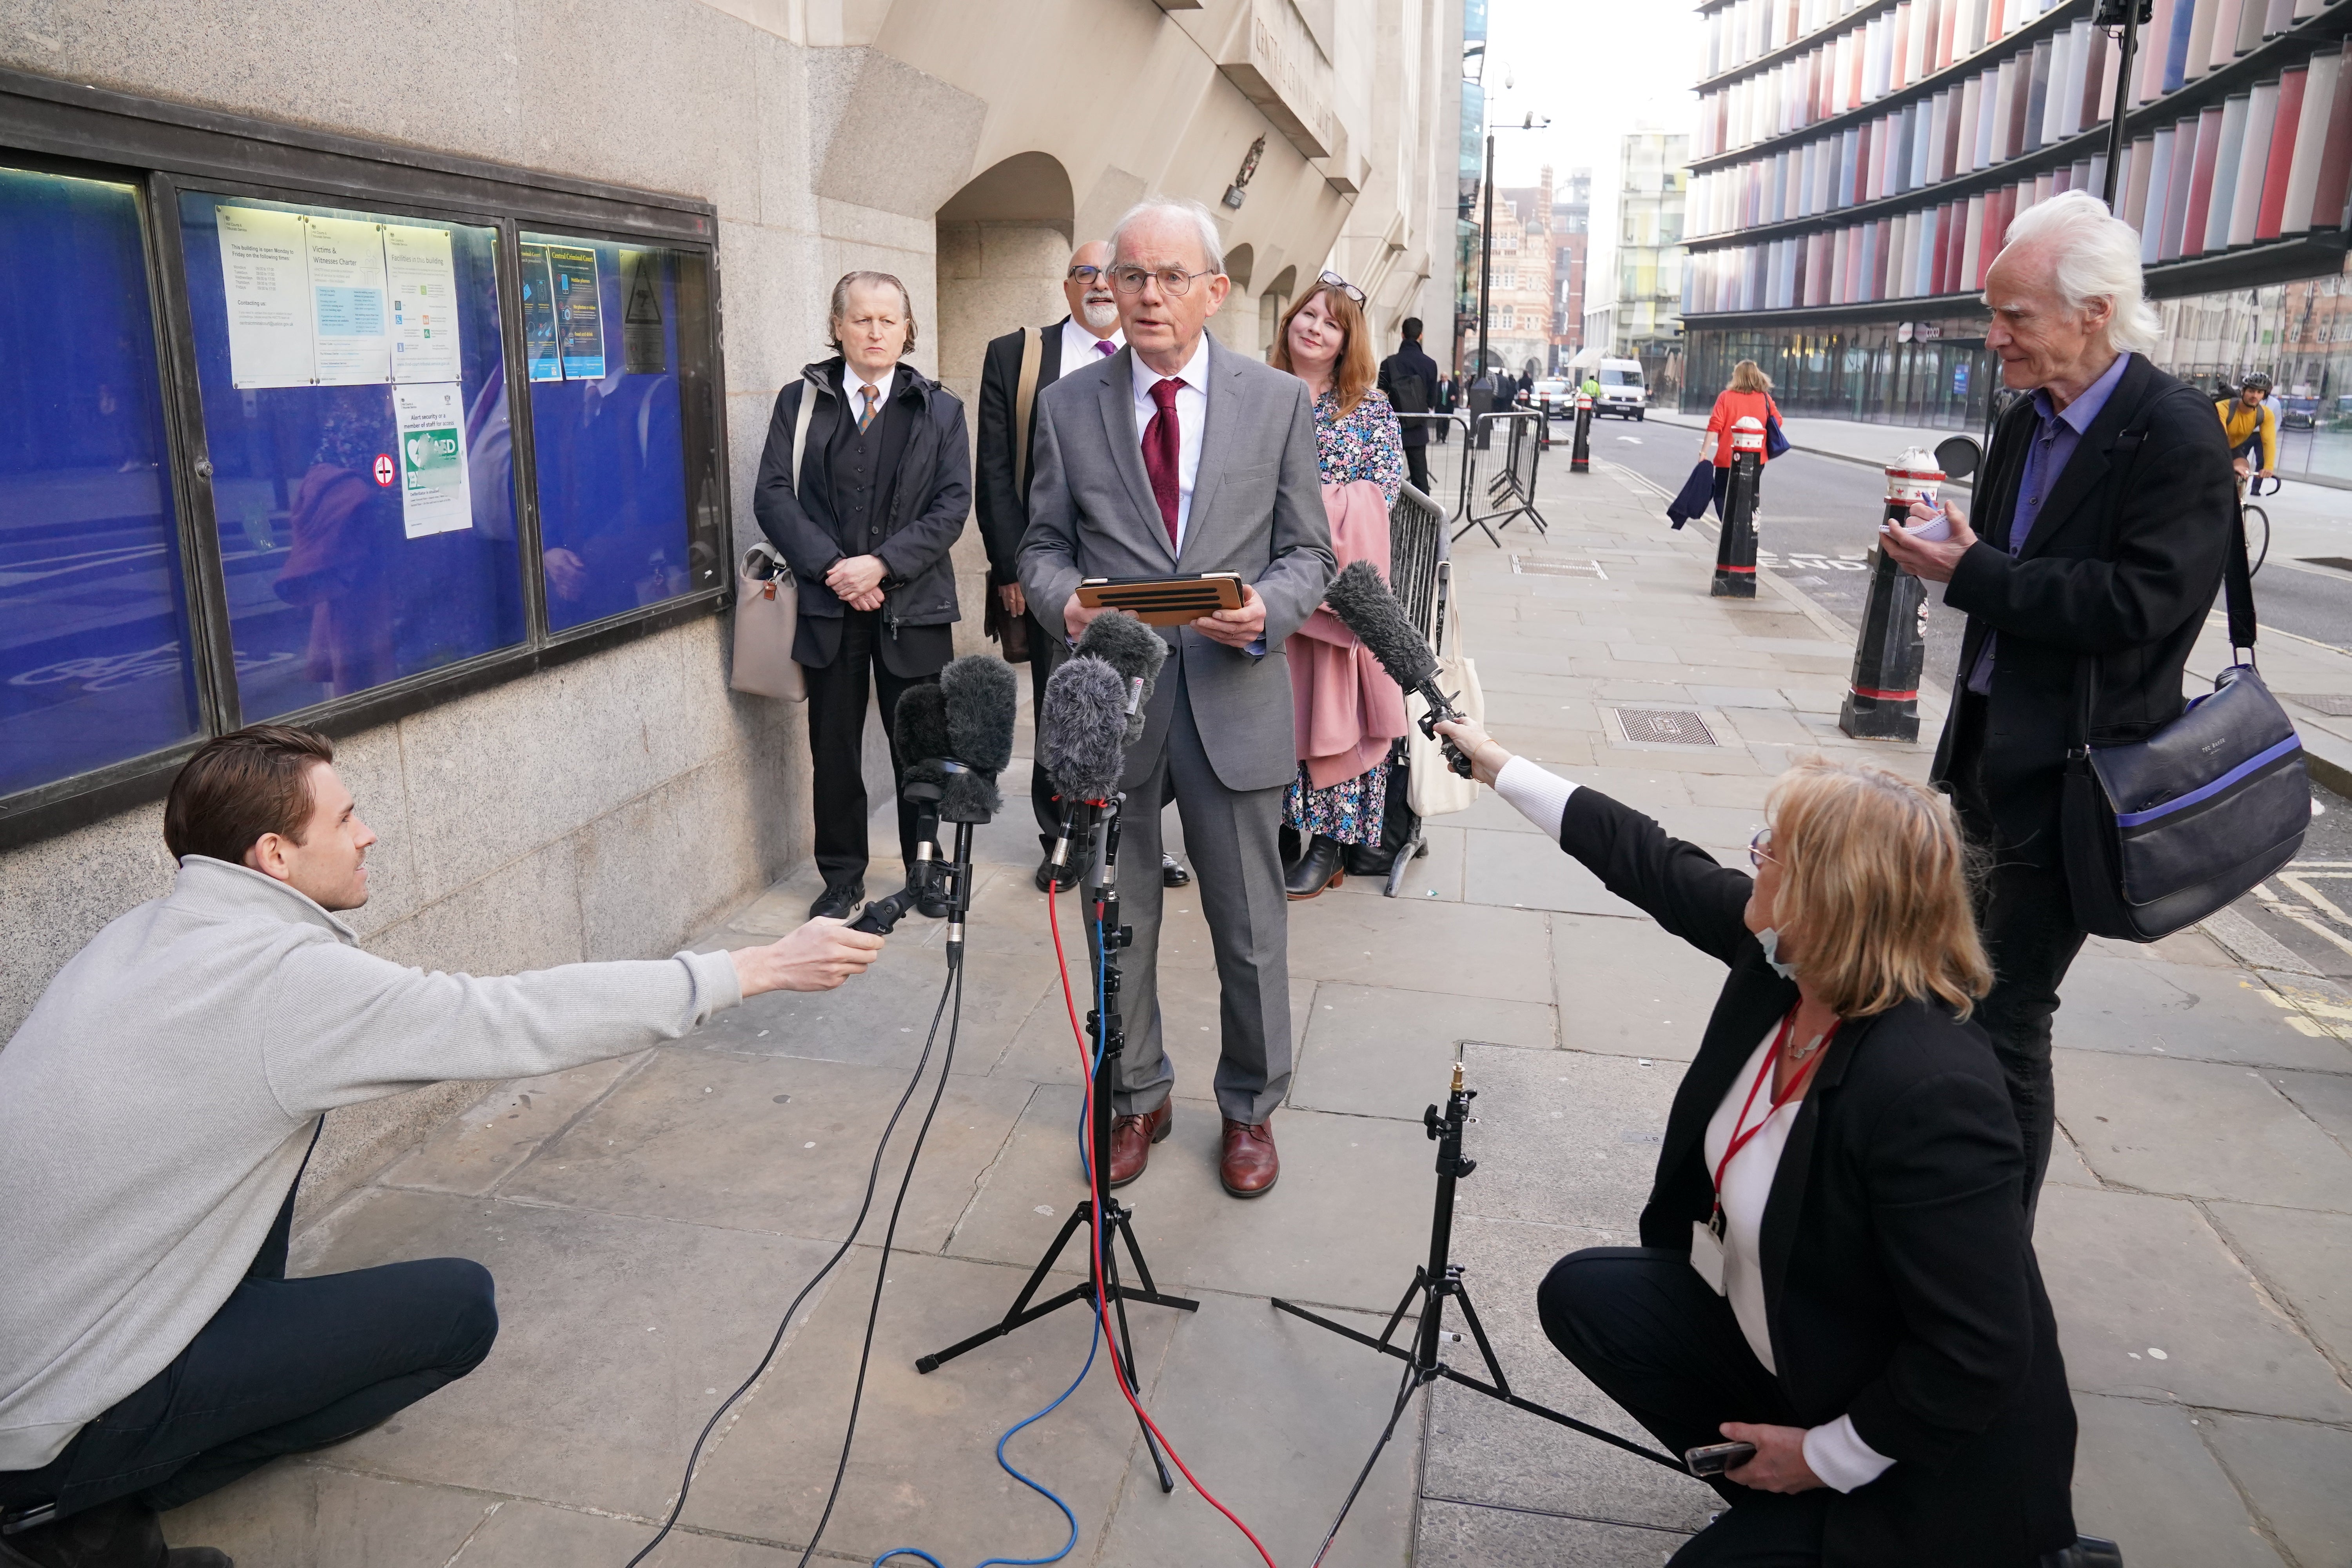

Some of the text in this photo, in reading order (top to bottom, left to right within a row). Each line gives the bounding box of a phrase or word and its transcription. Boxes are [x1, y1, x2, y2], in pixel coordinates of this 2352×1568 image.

[1256, 17, 1285, 83] CENTRAL
[1288, 62, 1315, 121] CRIMINAL
[312, 245, 331, 254] Victims
[313, 256, 338, 265] Witnesses
[426, 257, 444, 266] building
[1756, 557, 1867, 570] END
[1131, 685, 1140, 703] Rycote
